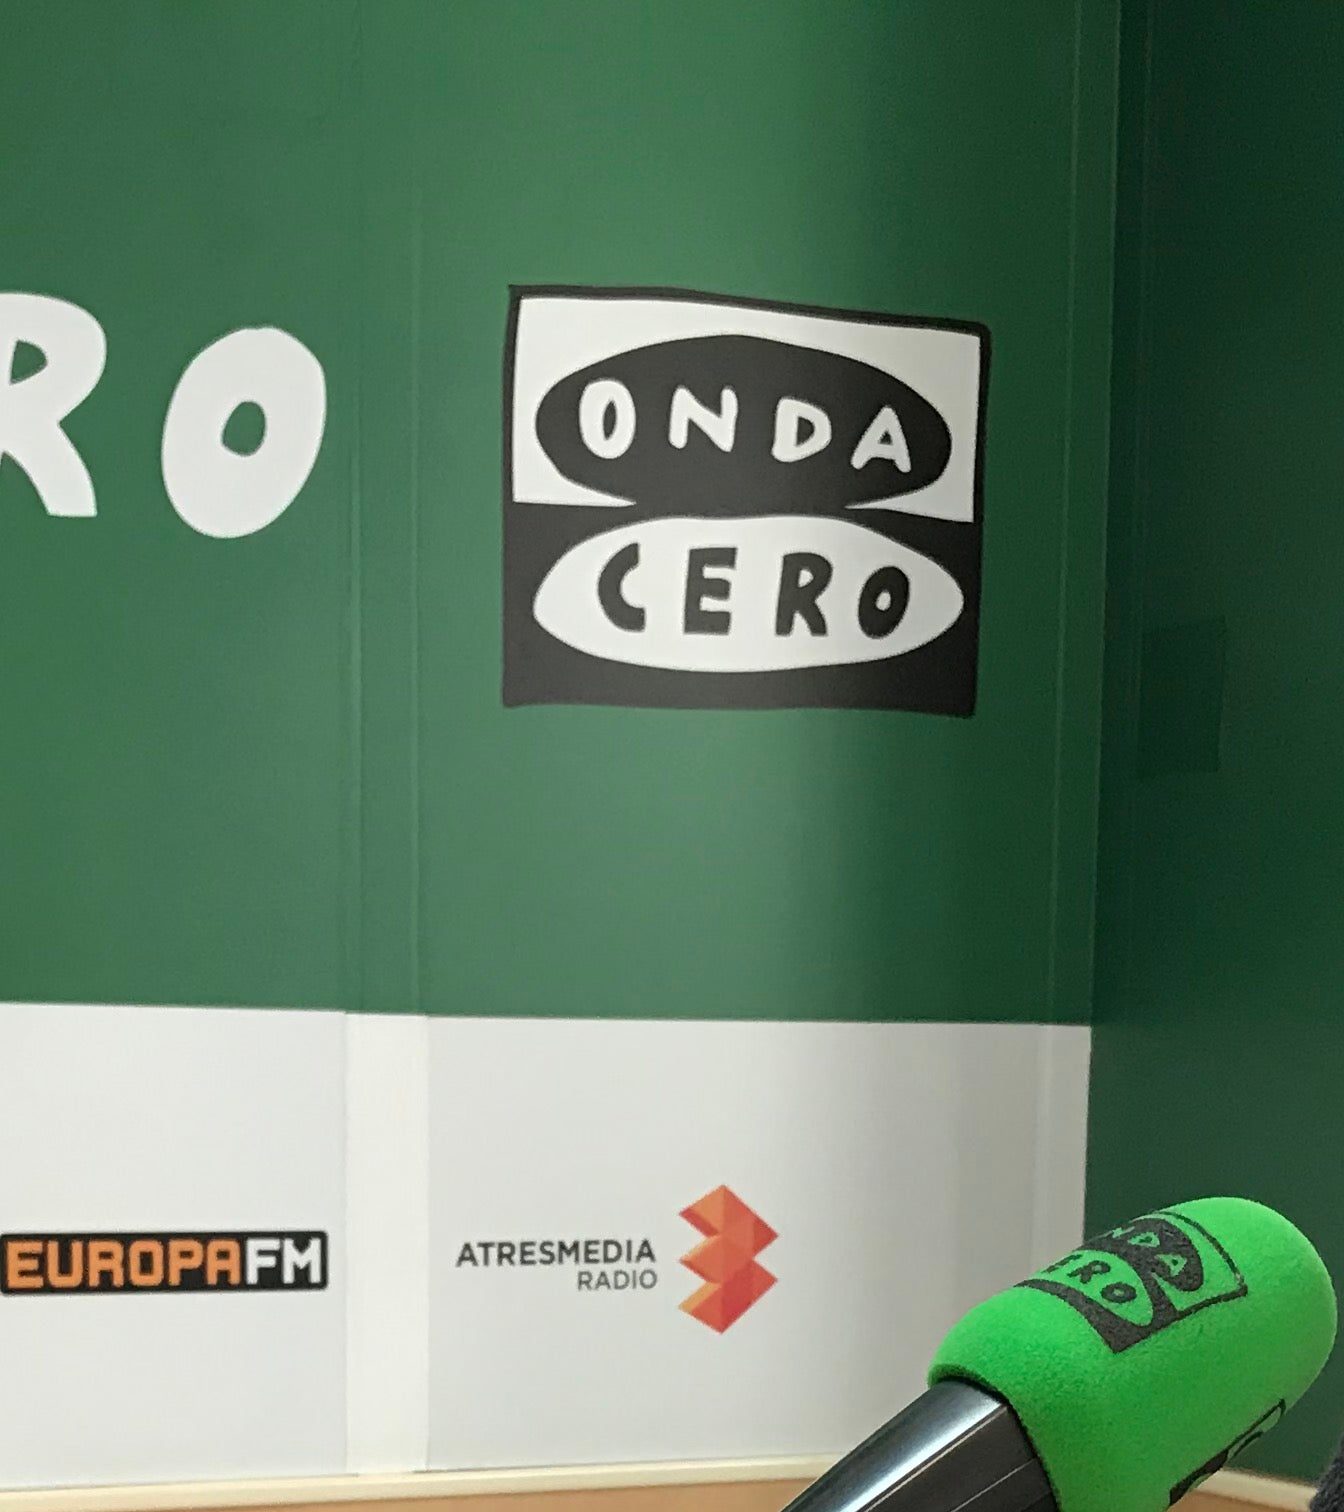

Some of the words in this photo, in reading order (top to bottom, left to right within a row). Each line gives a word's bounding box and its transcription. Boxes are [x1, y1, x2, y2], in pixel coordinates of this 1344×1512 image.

[578, 377, 912, 473] ONDA
[597, 541, 911, 640] CERO
[456, 1237, 657, 1268] ATRESMEDIA
[576, 1270, 658, 1292] RADIO
